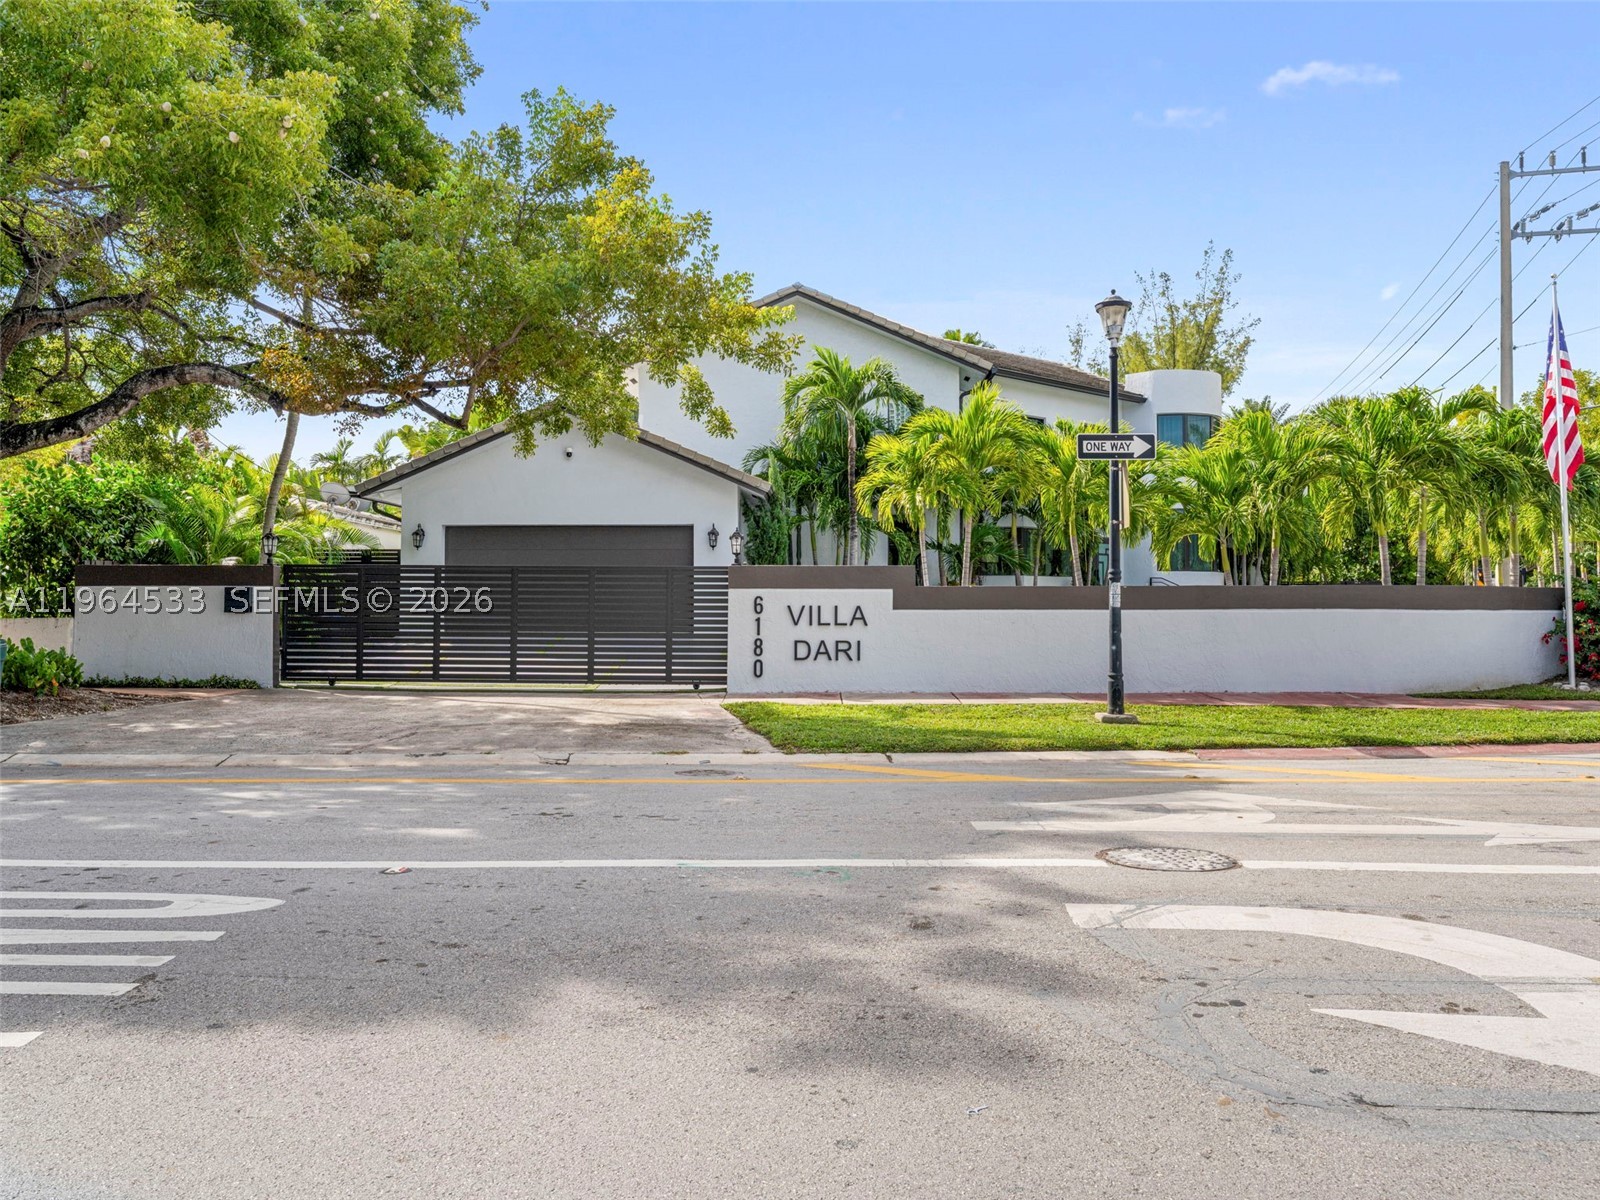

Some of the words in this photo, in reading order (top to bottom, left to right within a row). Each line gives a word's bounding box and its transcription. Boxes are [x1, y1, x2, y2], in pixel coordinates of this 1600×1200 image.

[1085, 442, 1107, 452] ONE
[1110, 442, 1132, 452] WAY
[787, 605, 868, 626] VILLA
[753, 595, 764, 678] 6180
[794, 640, 861, 661] DARI
